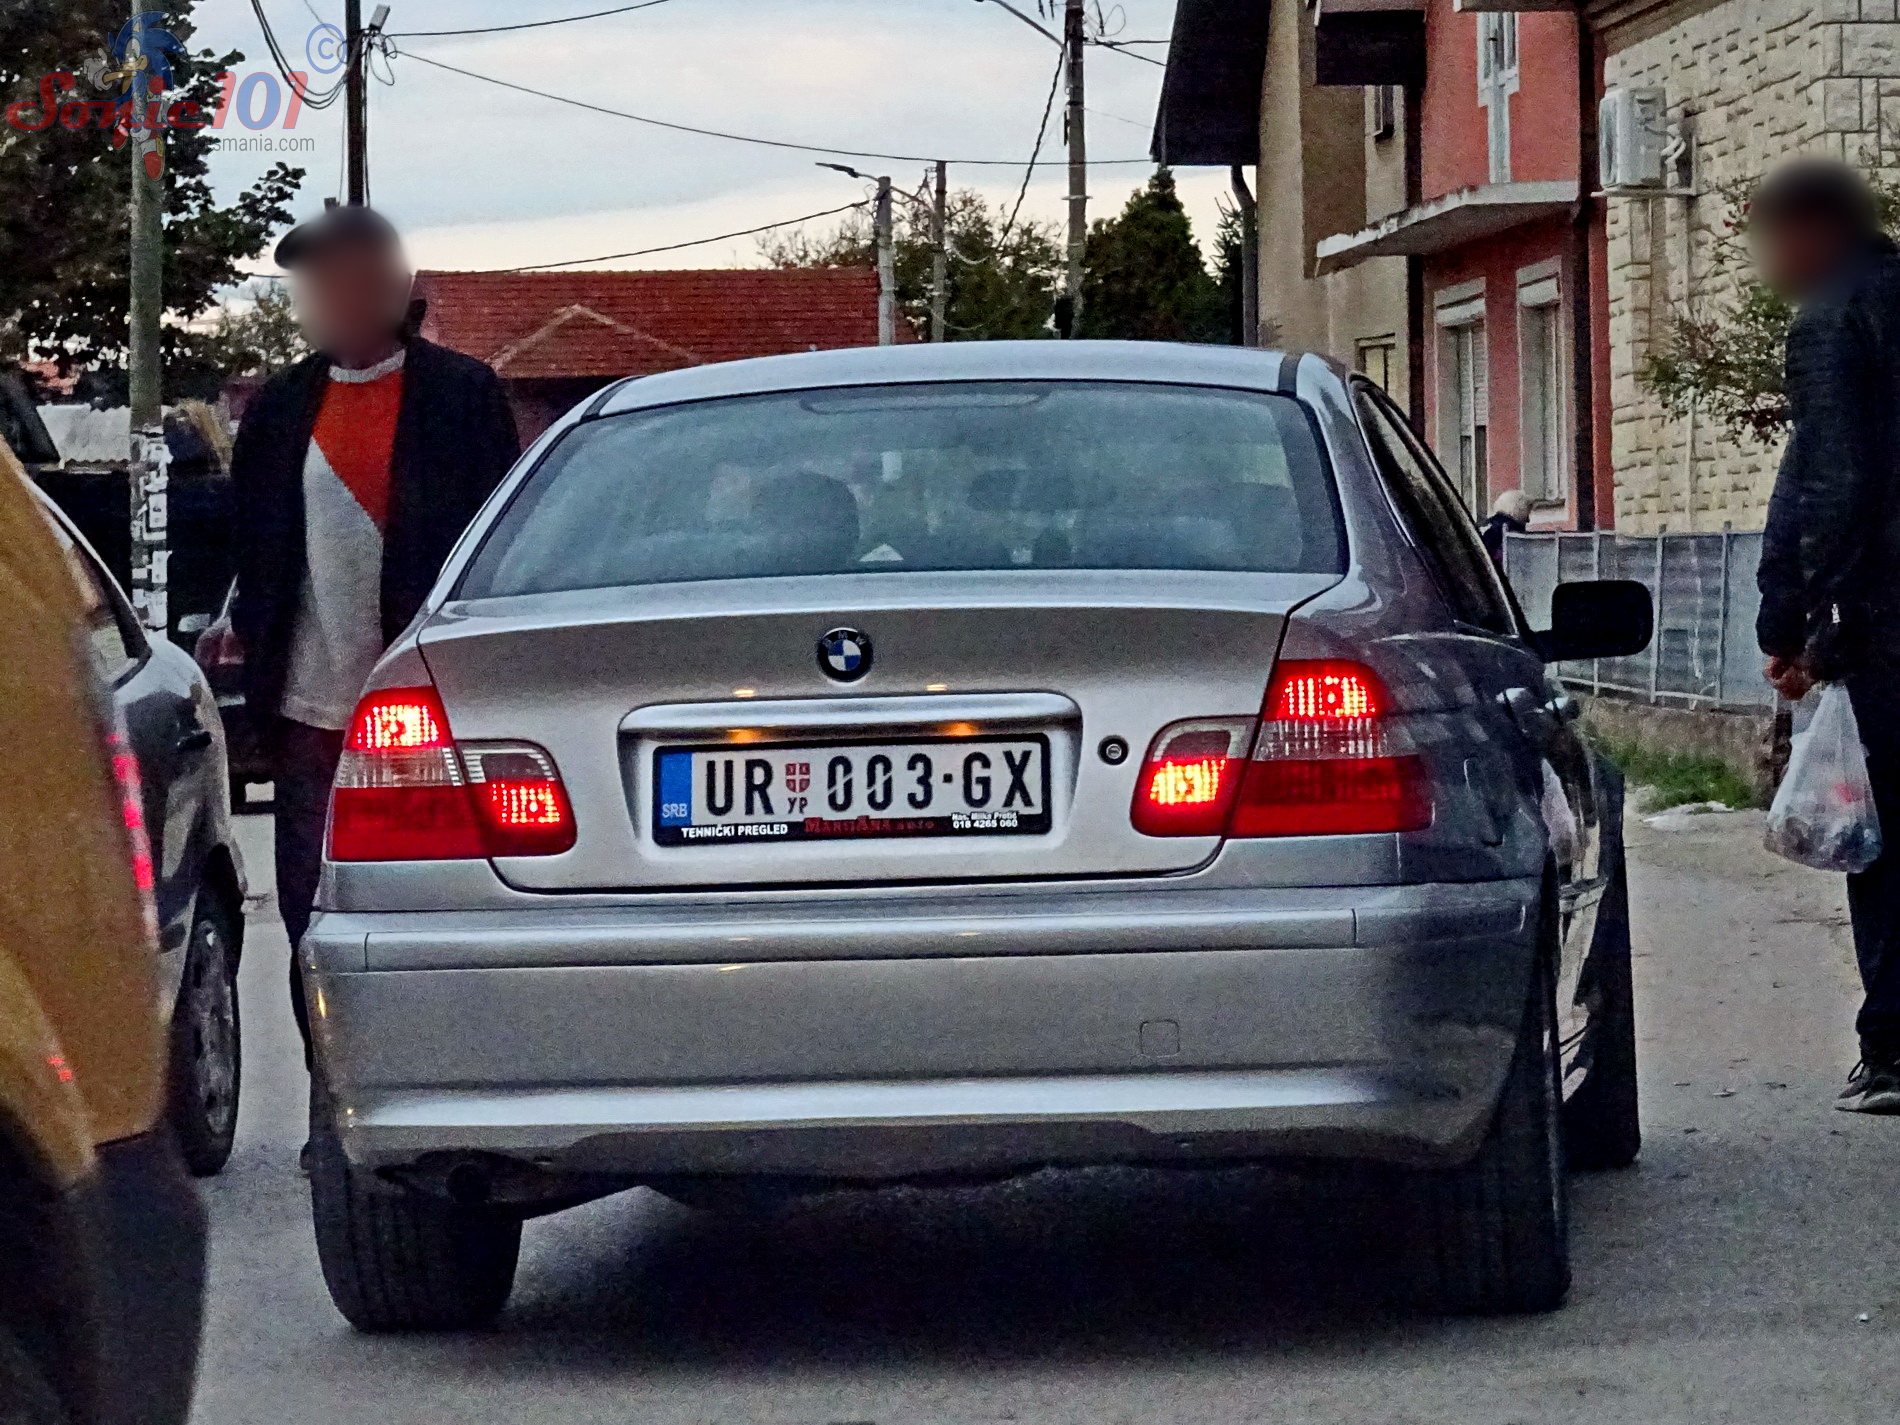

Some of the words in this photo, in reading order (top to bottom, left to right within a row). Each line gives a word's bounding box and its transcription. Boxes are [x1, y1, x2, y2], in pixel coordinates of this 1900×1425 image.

[706, 758, 775, 816] UR
[661, 802, 688, 818] SRB
[737, 823, 788, 836] PREGLED
[953, 820, 971, 829] 018
